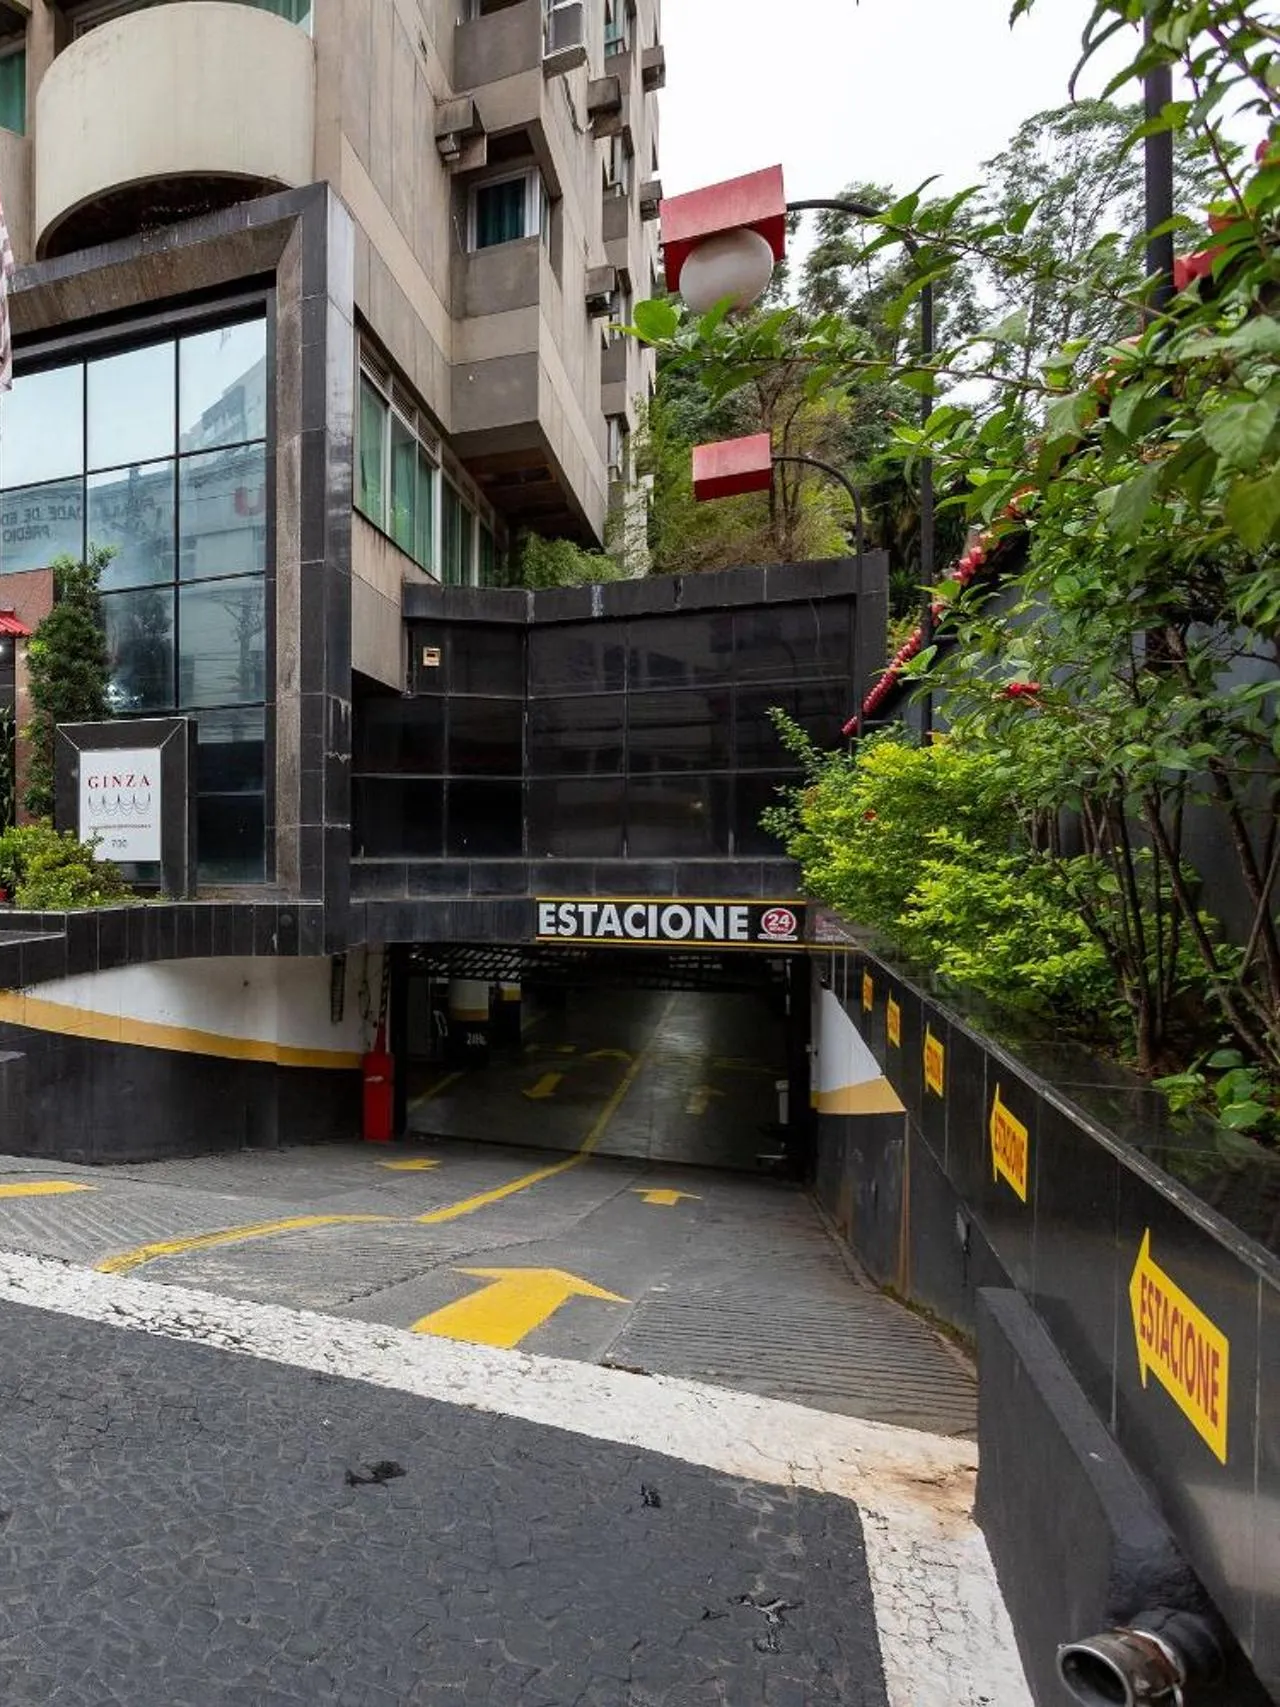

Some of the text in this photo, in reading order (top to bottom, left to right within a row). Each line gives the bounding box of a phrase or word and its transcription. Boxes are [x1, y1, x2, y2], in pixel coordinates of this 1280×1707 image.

[88, 775, 150, 789] GINZA
[538, 903, 792, 941] ESTACIONE 24
[1140, 1271, 1220, 1428] ESTACIONE
